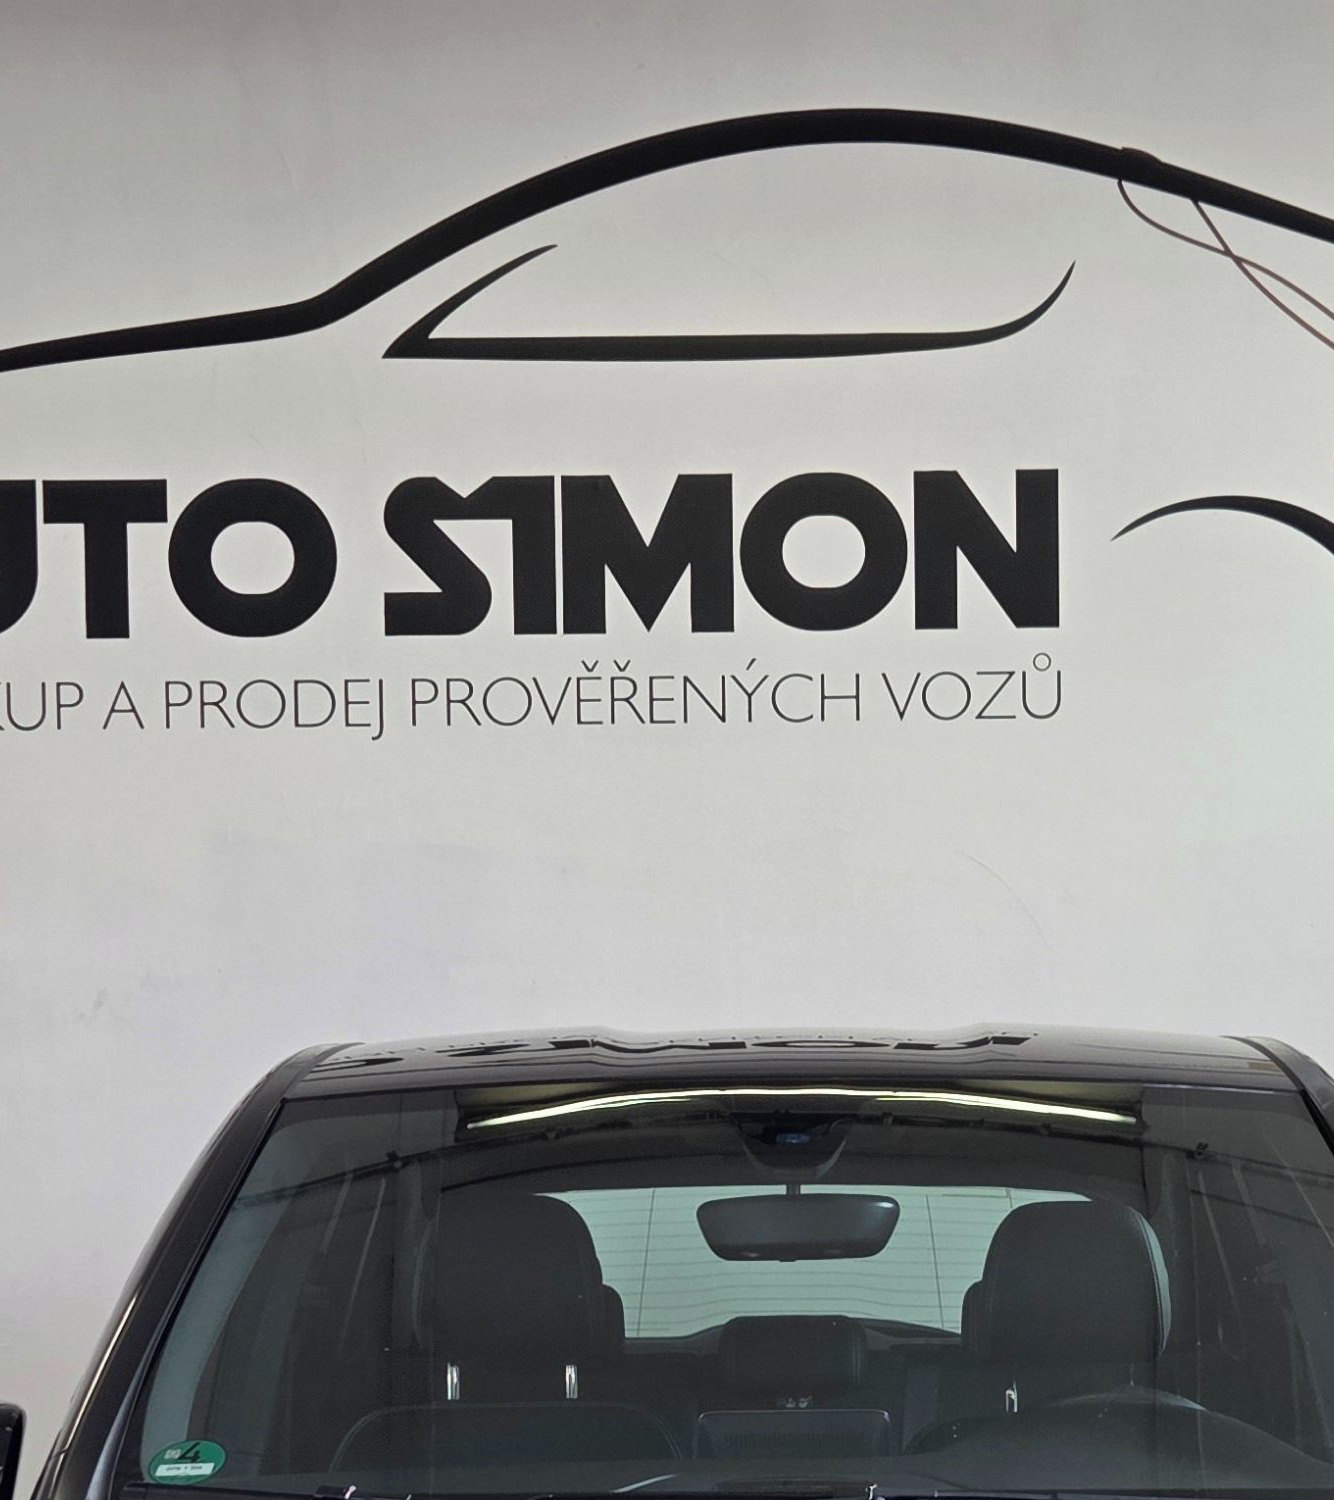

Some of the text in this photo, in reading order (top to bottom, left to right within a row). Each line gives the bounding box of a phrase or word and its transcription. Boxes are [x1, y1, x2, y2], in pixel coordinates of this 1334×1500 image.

[383, 468, 1060, 637] SIMON
[101, 680, 146, 731] A
[164, 677, 384, 741] PRODEJ
[411, 656, 861, 728] PROVĚŘENÝCH
[880, 652, 1063, 721] VOZŮ
[177, 1442, 201, 1463] 4
